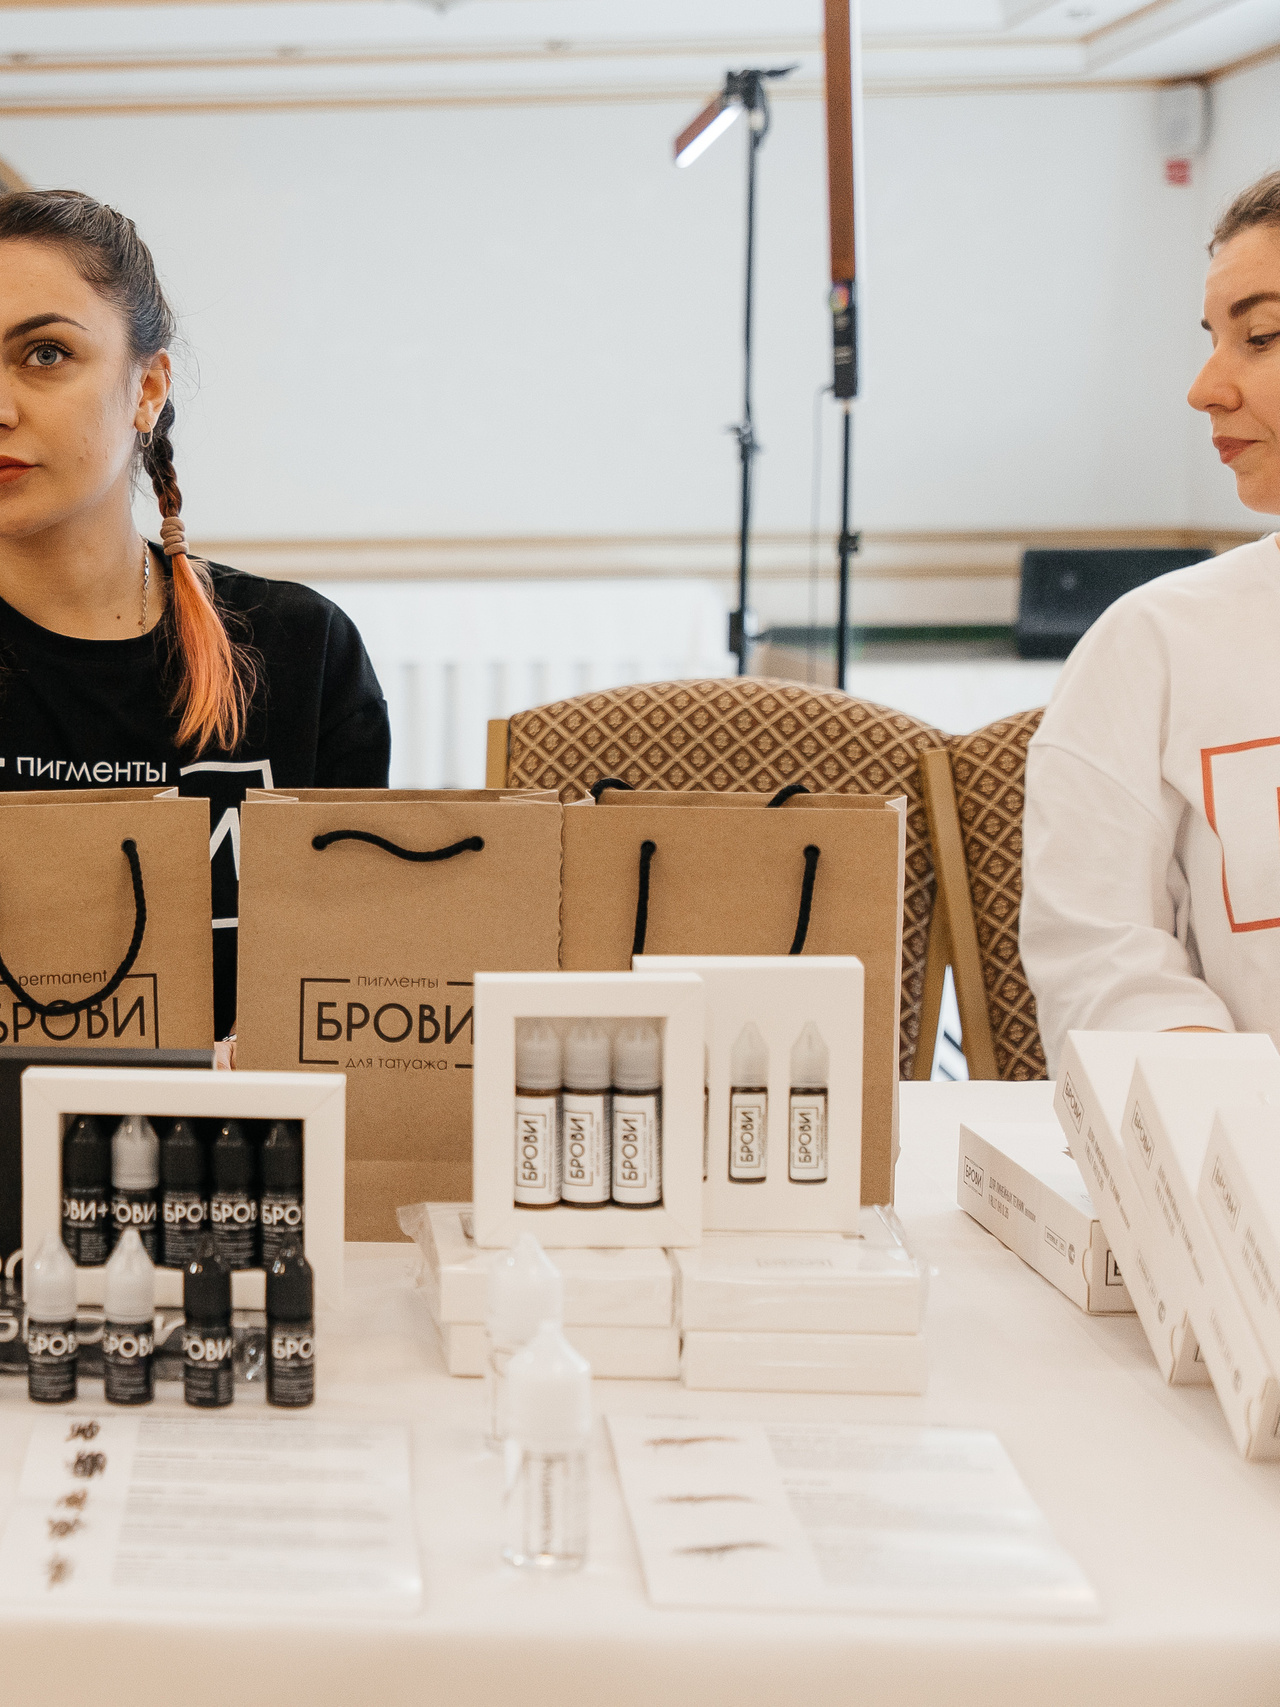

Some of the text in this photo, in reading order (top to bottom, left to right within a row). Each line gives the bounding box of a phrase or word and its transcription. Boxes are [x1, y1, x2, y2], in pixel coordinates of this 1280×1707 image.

[16, 756, 167, 783] пигменты
[18, 969, 108, 987] permanent
[357, 976, 439, 989] пигменты
[317, 1001, 474, 1045] БРОВИ
[345, 1057, 448, 1072] для татуажа
[522, 1119, 538, 1181] БРОВИ
[570, 1117, 585, 1179] БРОВИ
[622, 1118, 638, 1181] БРОВИ
[740, 1111, 754, 1162] БРОВИ
[798, 1112, 812, 1163] БРОВИ
